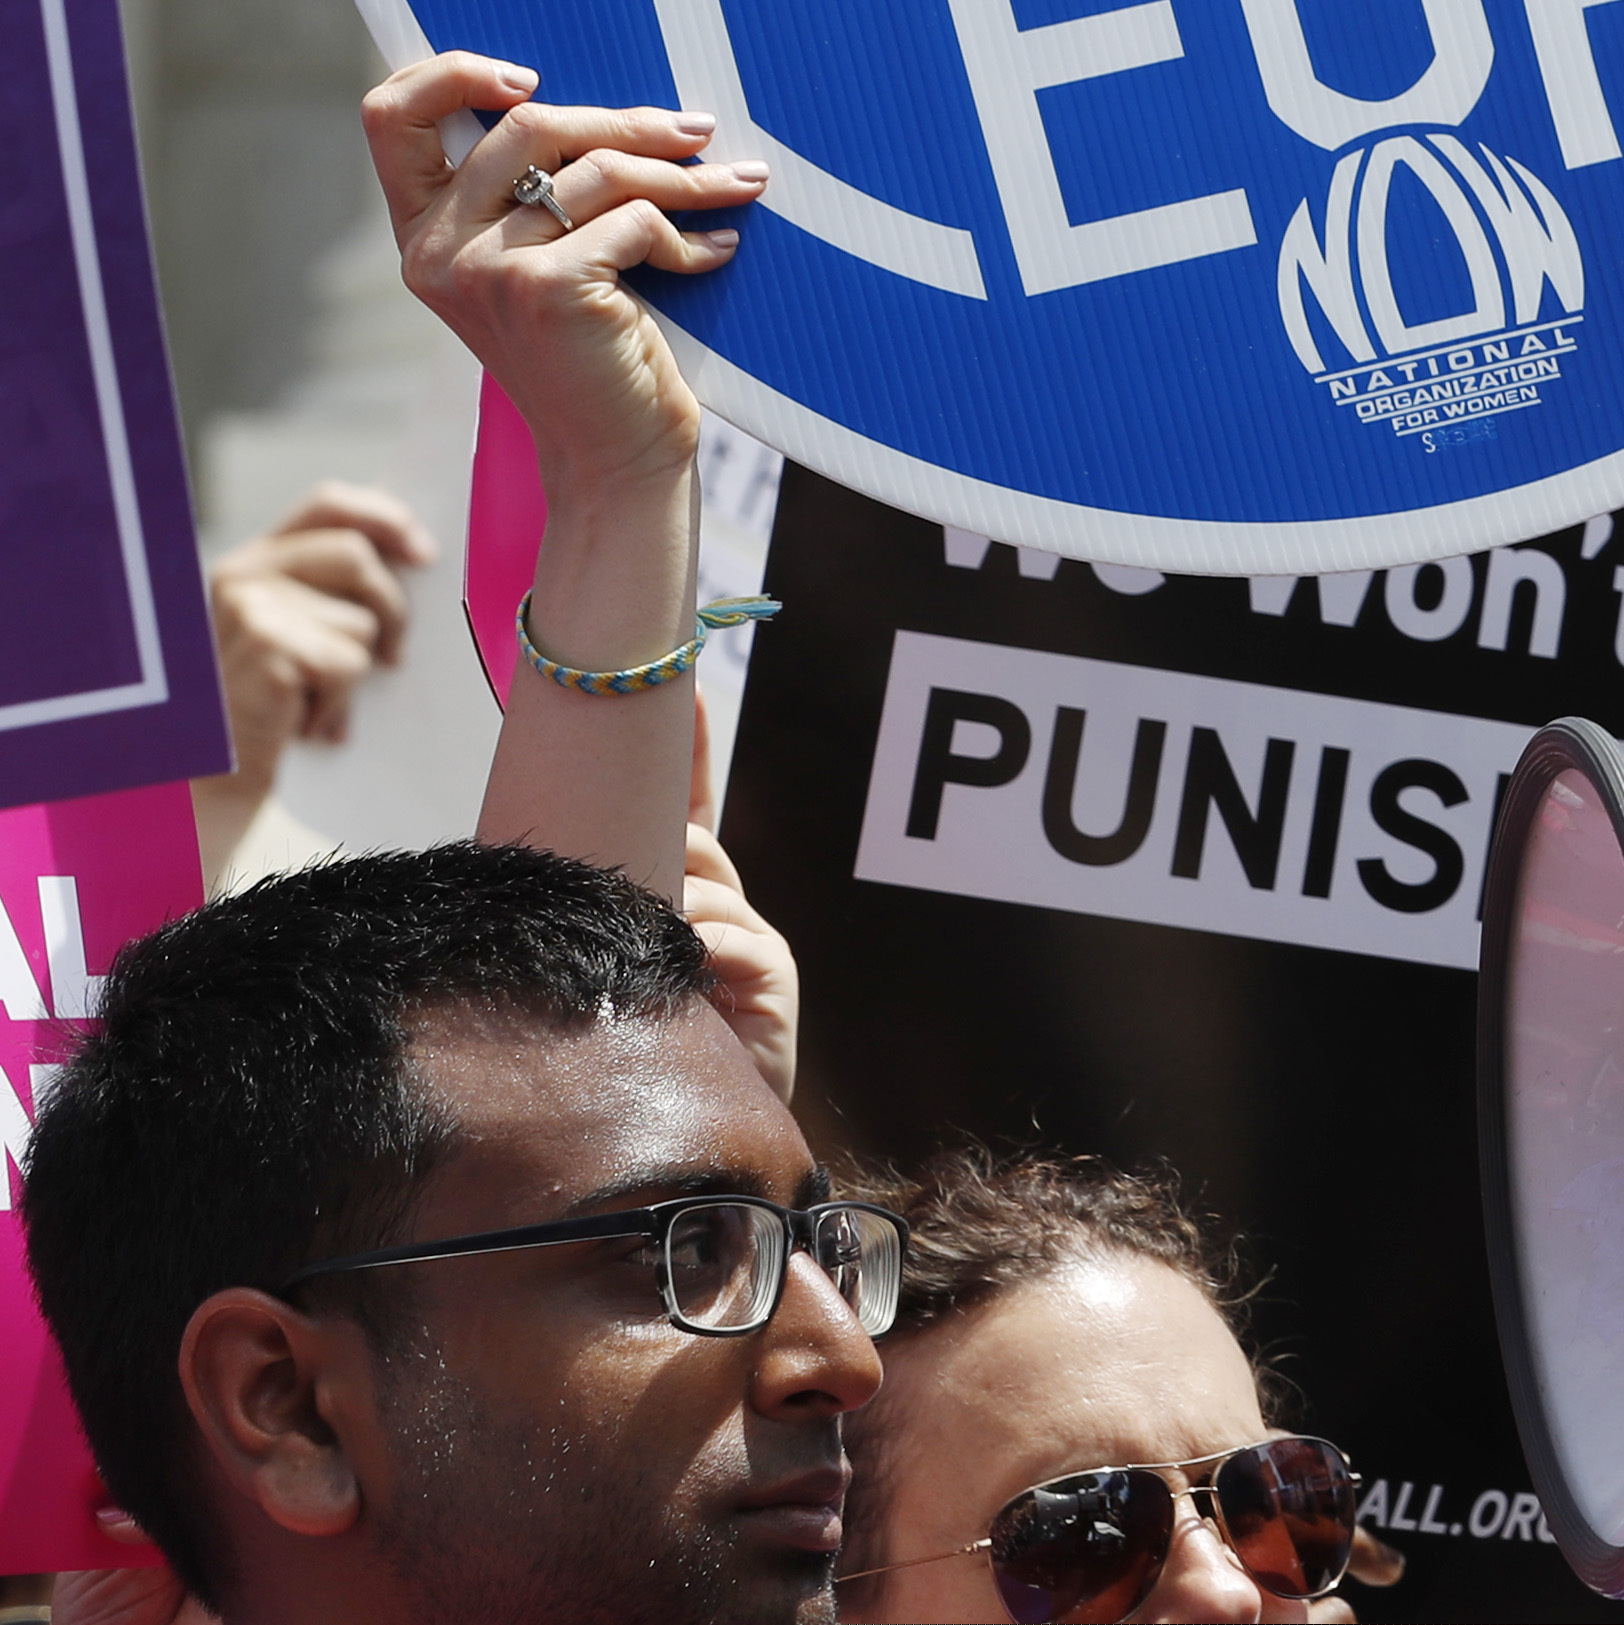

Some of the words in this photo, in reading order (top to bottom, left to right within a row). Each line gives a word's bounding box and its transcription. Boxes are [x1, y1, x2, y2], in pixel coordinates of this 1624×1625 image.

[1276, 133, 1585, 375] NOW
[1329, 328, 1576, 399] NATIONAL
[1355, 357, 1559, 418] ORGANIZATION
[1391, 409, 1440, 431] FOR
[1443, 386, 1538, 418] WOMEN
